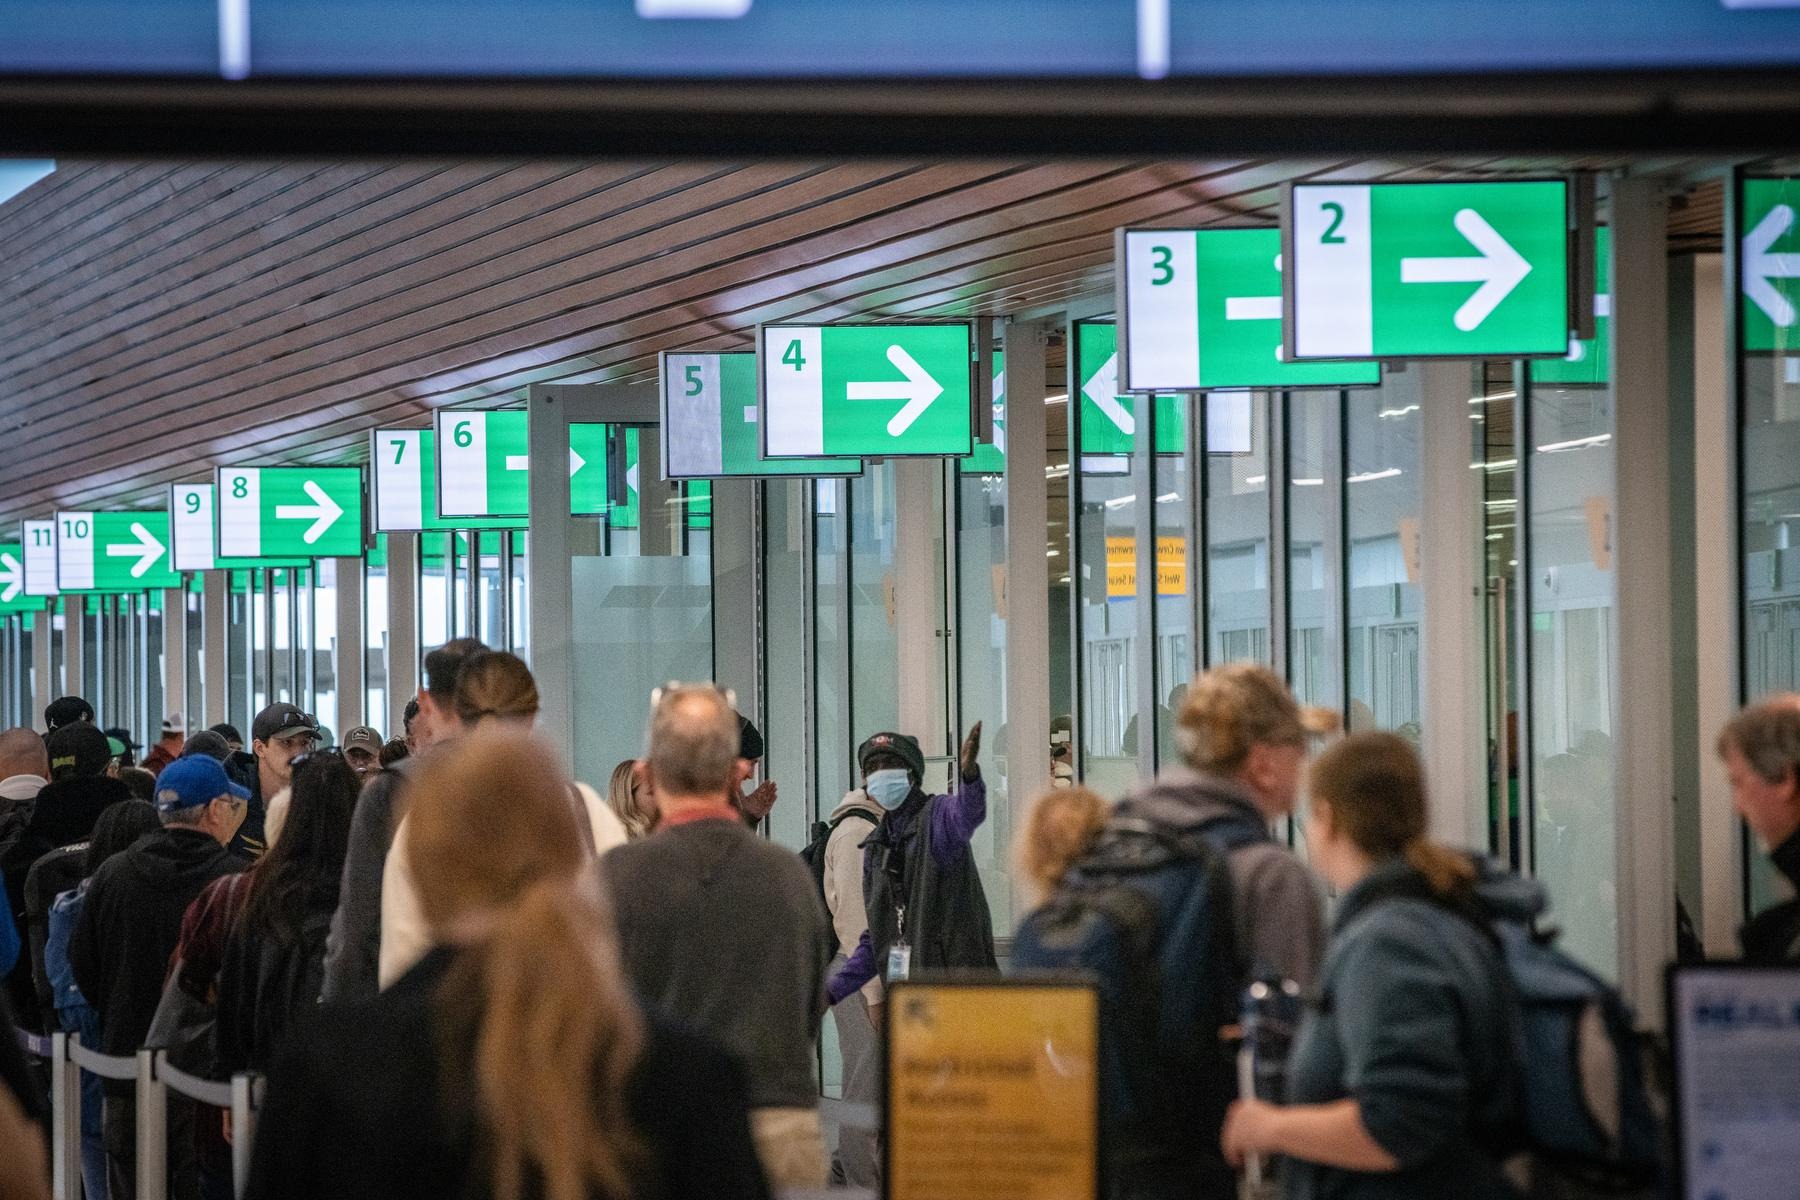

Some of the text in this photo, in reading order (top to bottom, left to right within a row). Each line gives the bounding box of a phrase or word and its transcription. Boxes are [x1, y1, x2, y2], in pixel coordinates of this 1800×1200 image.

[1320, 201, 1346, 245] 2
[1151, 245, 1175, 286] 3
[781, 340, 807, 372] 4
[685, 365, 704, 397] 5
[453, 420, 473, 448] 6
[390, 440, 406, 465] 7
[232, 476, 248, 499] 8
[185, 492, 201, 514] 9
[32, 528, 51, 546] 11
[63, 519, 89, 539] 10
